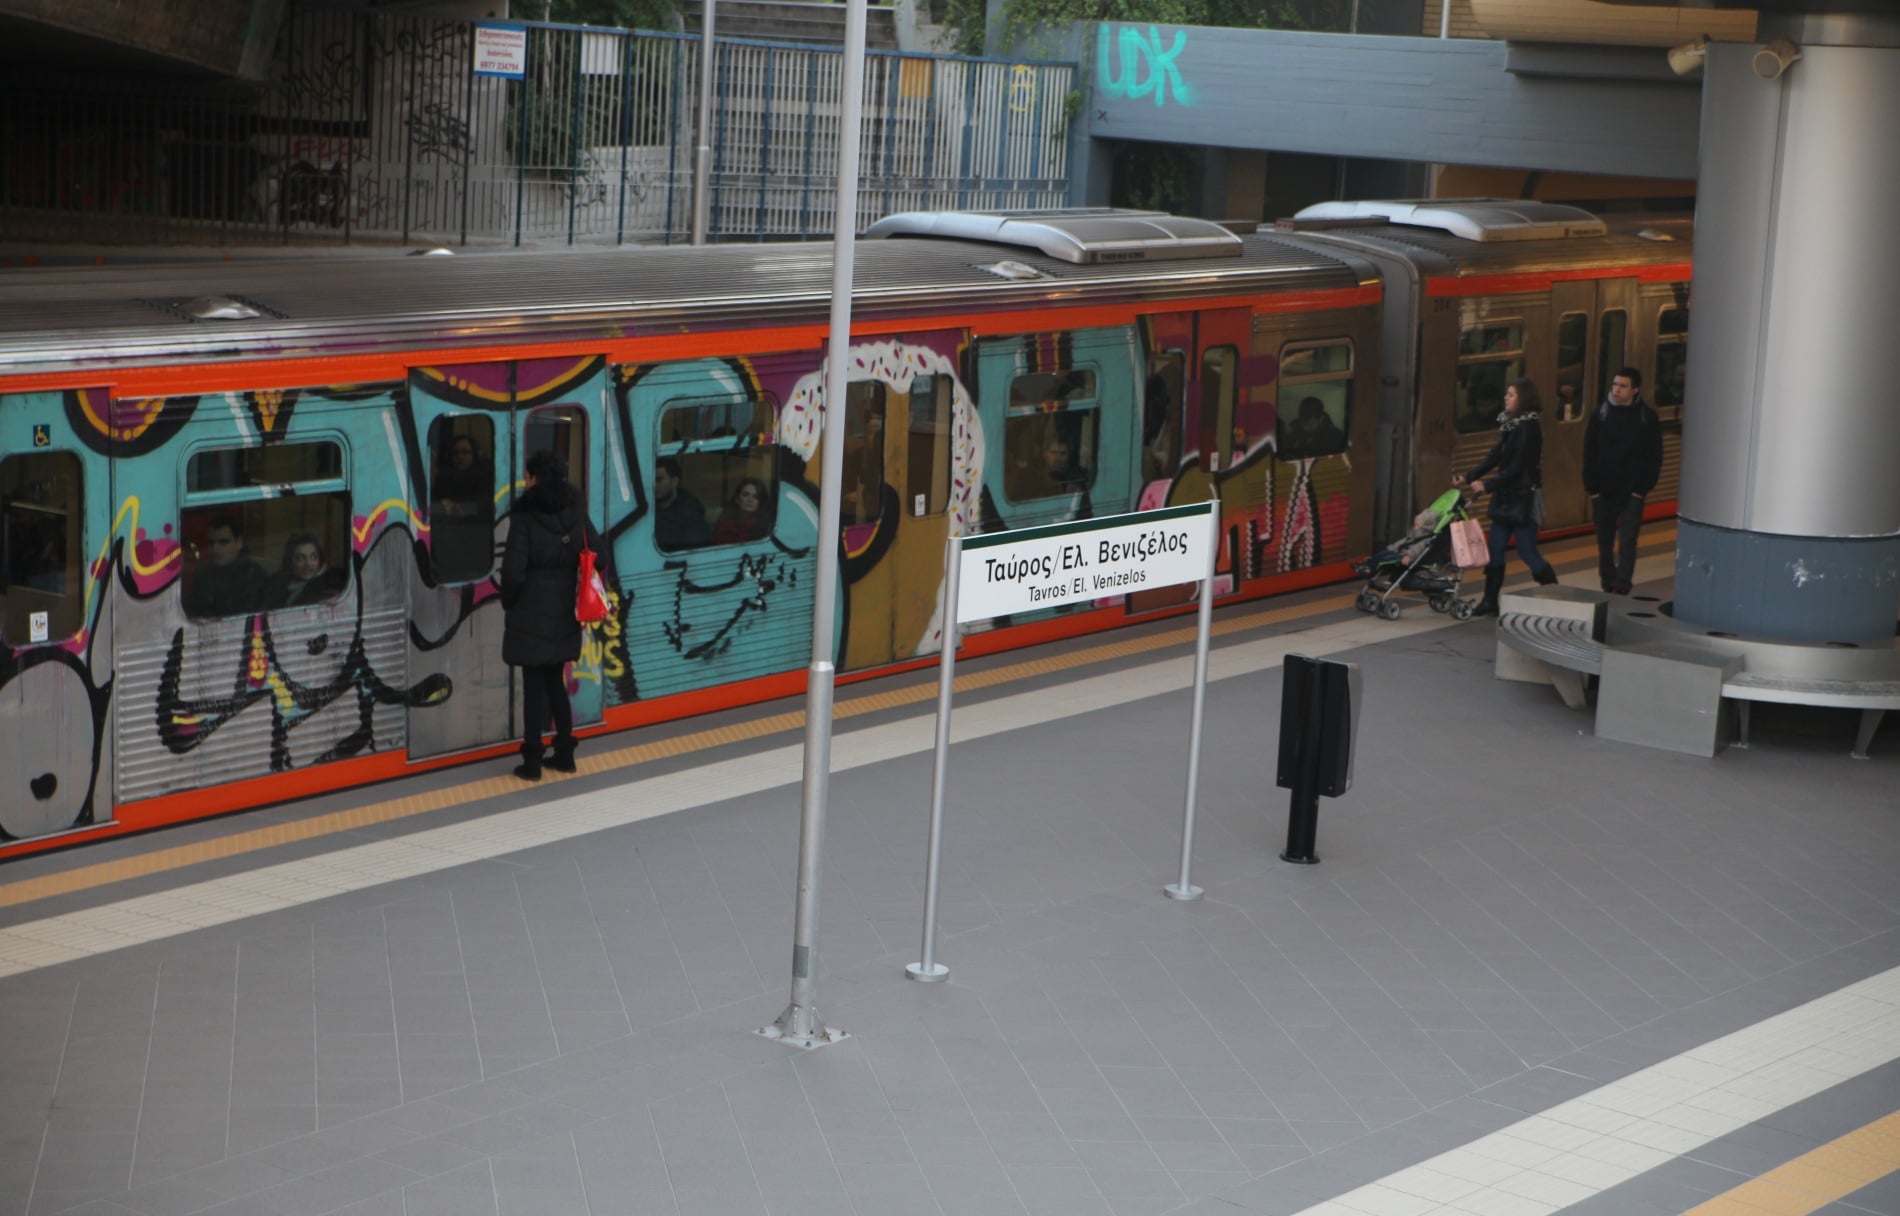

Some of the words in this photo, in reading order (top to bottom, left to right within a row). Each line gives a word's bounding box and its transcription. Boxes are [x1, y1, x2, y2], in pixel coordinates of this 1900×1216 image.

[1098, 22, 1194, 106] UDK
[985, 544, 1088, 583] Ταύρος/Ελ.
[1098, 531, 1188, 564] Βενιζέλος
[1028, 577, 1087, 602] Tavros/El.
[1092, 569, 1146, 590] Venizelos
